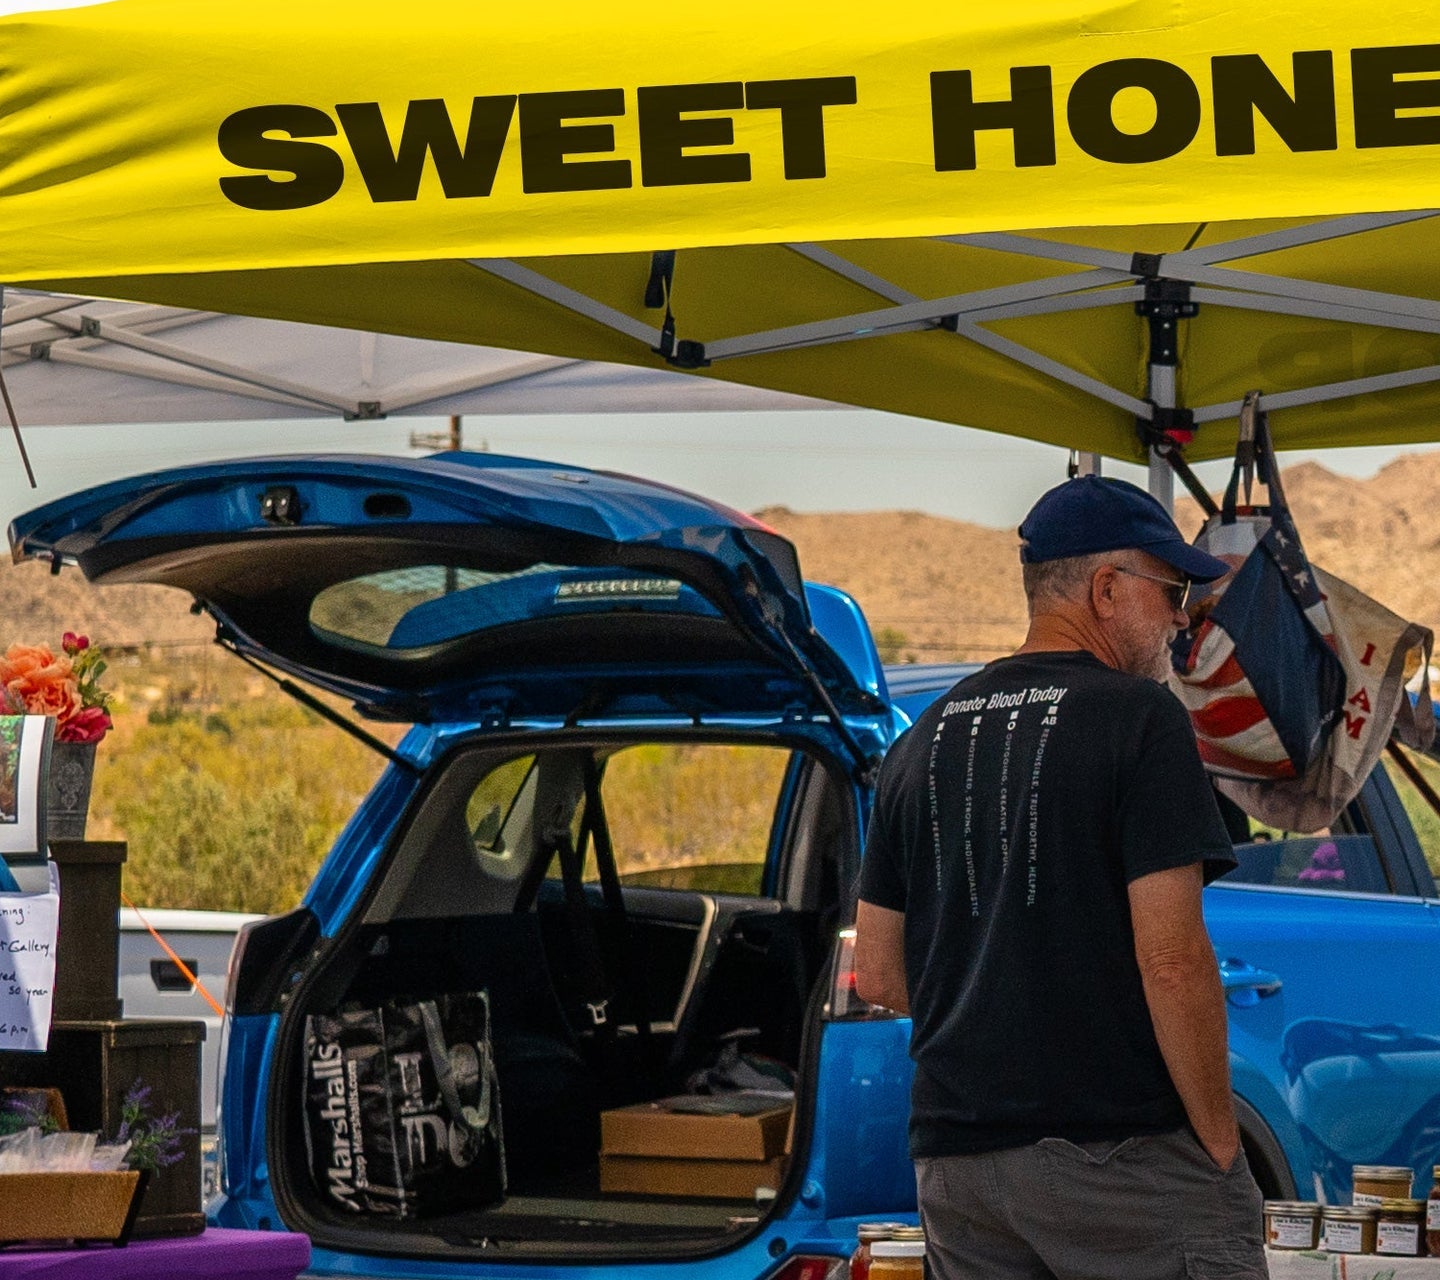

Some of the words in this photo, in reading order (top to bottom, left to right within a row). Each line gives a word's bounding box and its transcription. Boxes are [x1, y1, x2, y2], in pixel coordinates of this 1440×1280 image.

[217, 75, 857, 211] SWEET
[942, 696, 987, 718] Donate
[986, 688, 1028, 710] Blood
[1027, 685, 1068, 705] Today
[933, 733, 941, 742] A
[971, 726, 978, 736] B
[1007, 721, 1016, 731] O
[1041, 716, 1058, 726] AB
[1028, 793, 1039, 863] TRUSTWORTHY,
[964, 840, 979, 917] INDIVIDUALISTIC
[312, 1043, 361, 1211] Marshalls
